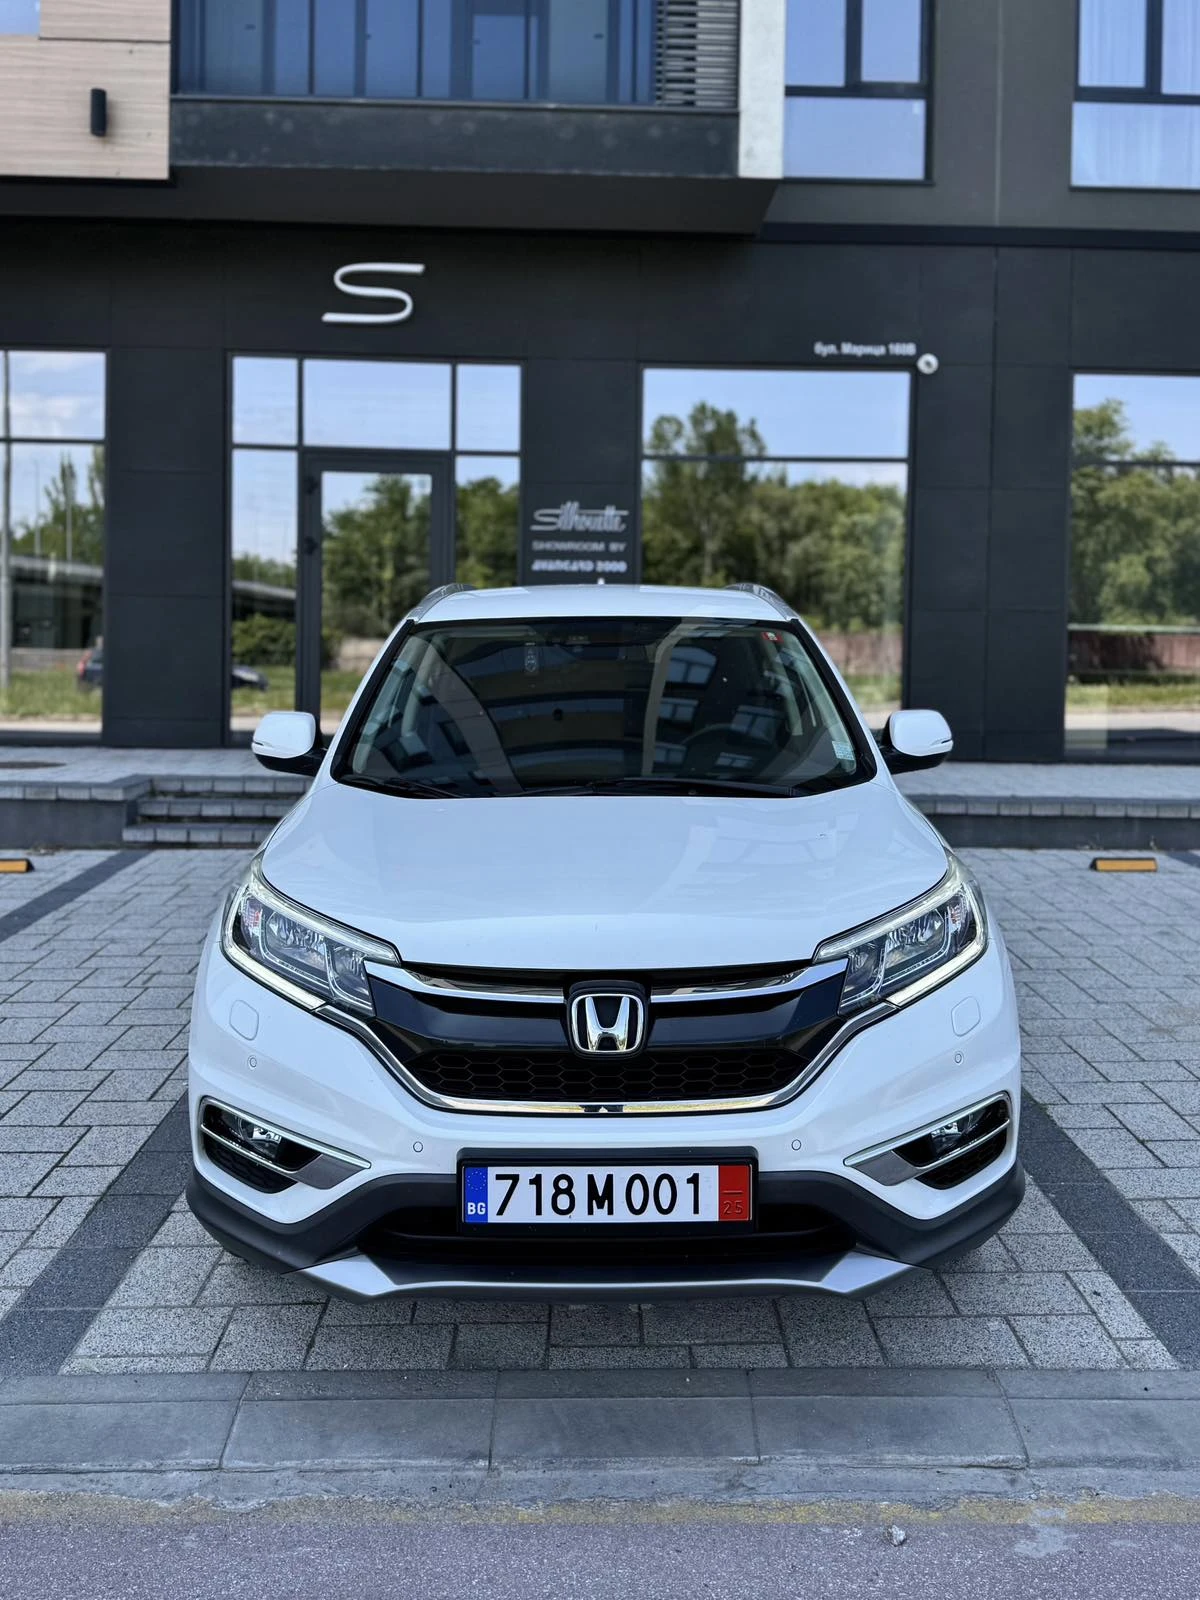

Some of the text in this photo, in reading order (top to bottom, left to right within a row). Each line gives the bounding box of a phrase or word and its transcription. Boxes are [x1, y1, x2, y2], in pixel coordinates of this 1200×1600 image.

[322, 262, 425, 324] S
[531, 541, 627, 552] SHOWROOM BY
[467, 1202, 486, 1216] BG
